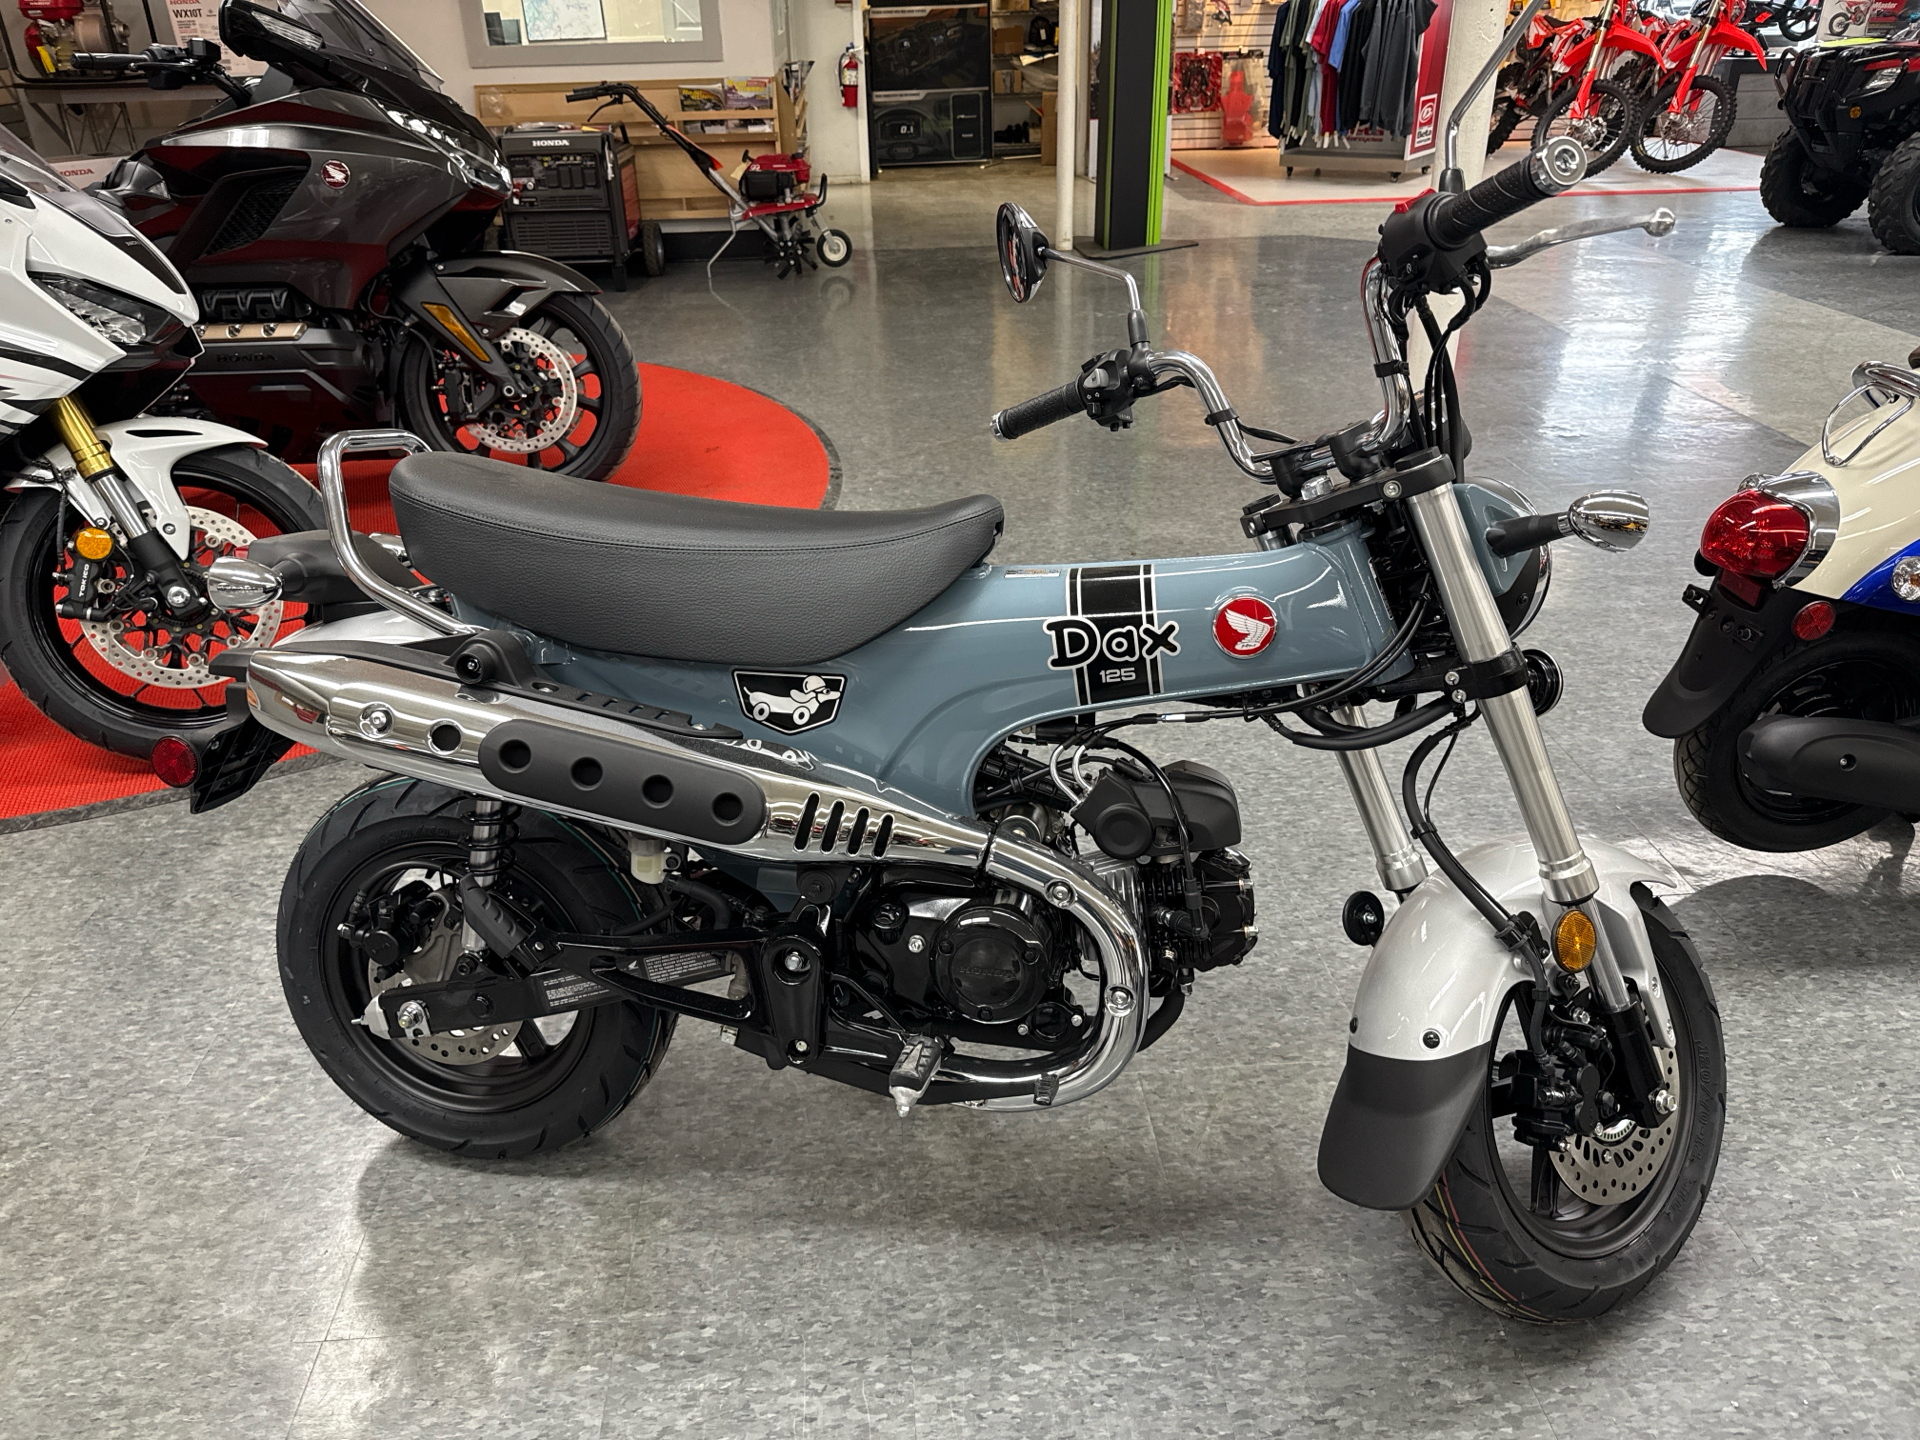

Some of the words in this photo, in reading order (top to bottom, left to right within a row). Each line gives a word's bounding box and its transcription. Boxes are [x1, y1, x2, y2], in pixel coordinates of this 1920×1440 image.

[172, 8, 203, 18] WX10T
[1416, 129, 1432, 139] Beta
[531, 139, 570, 147] HONDA
[215, 353, 277, 362] HONDA
[78, 563, 90, 598] TOKICO
[1042, 616, 1182, 671] Dax
[1099, 667, 1137, 684] 125
[958, 965, 1017, 979] HONDA
